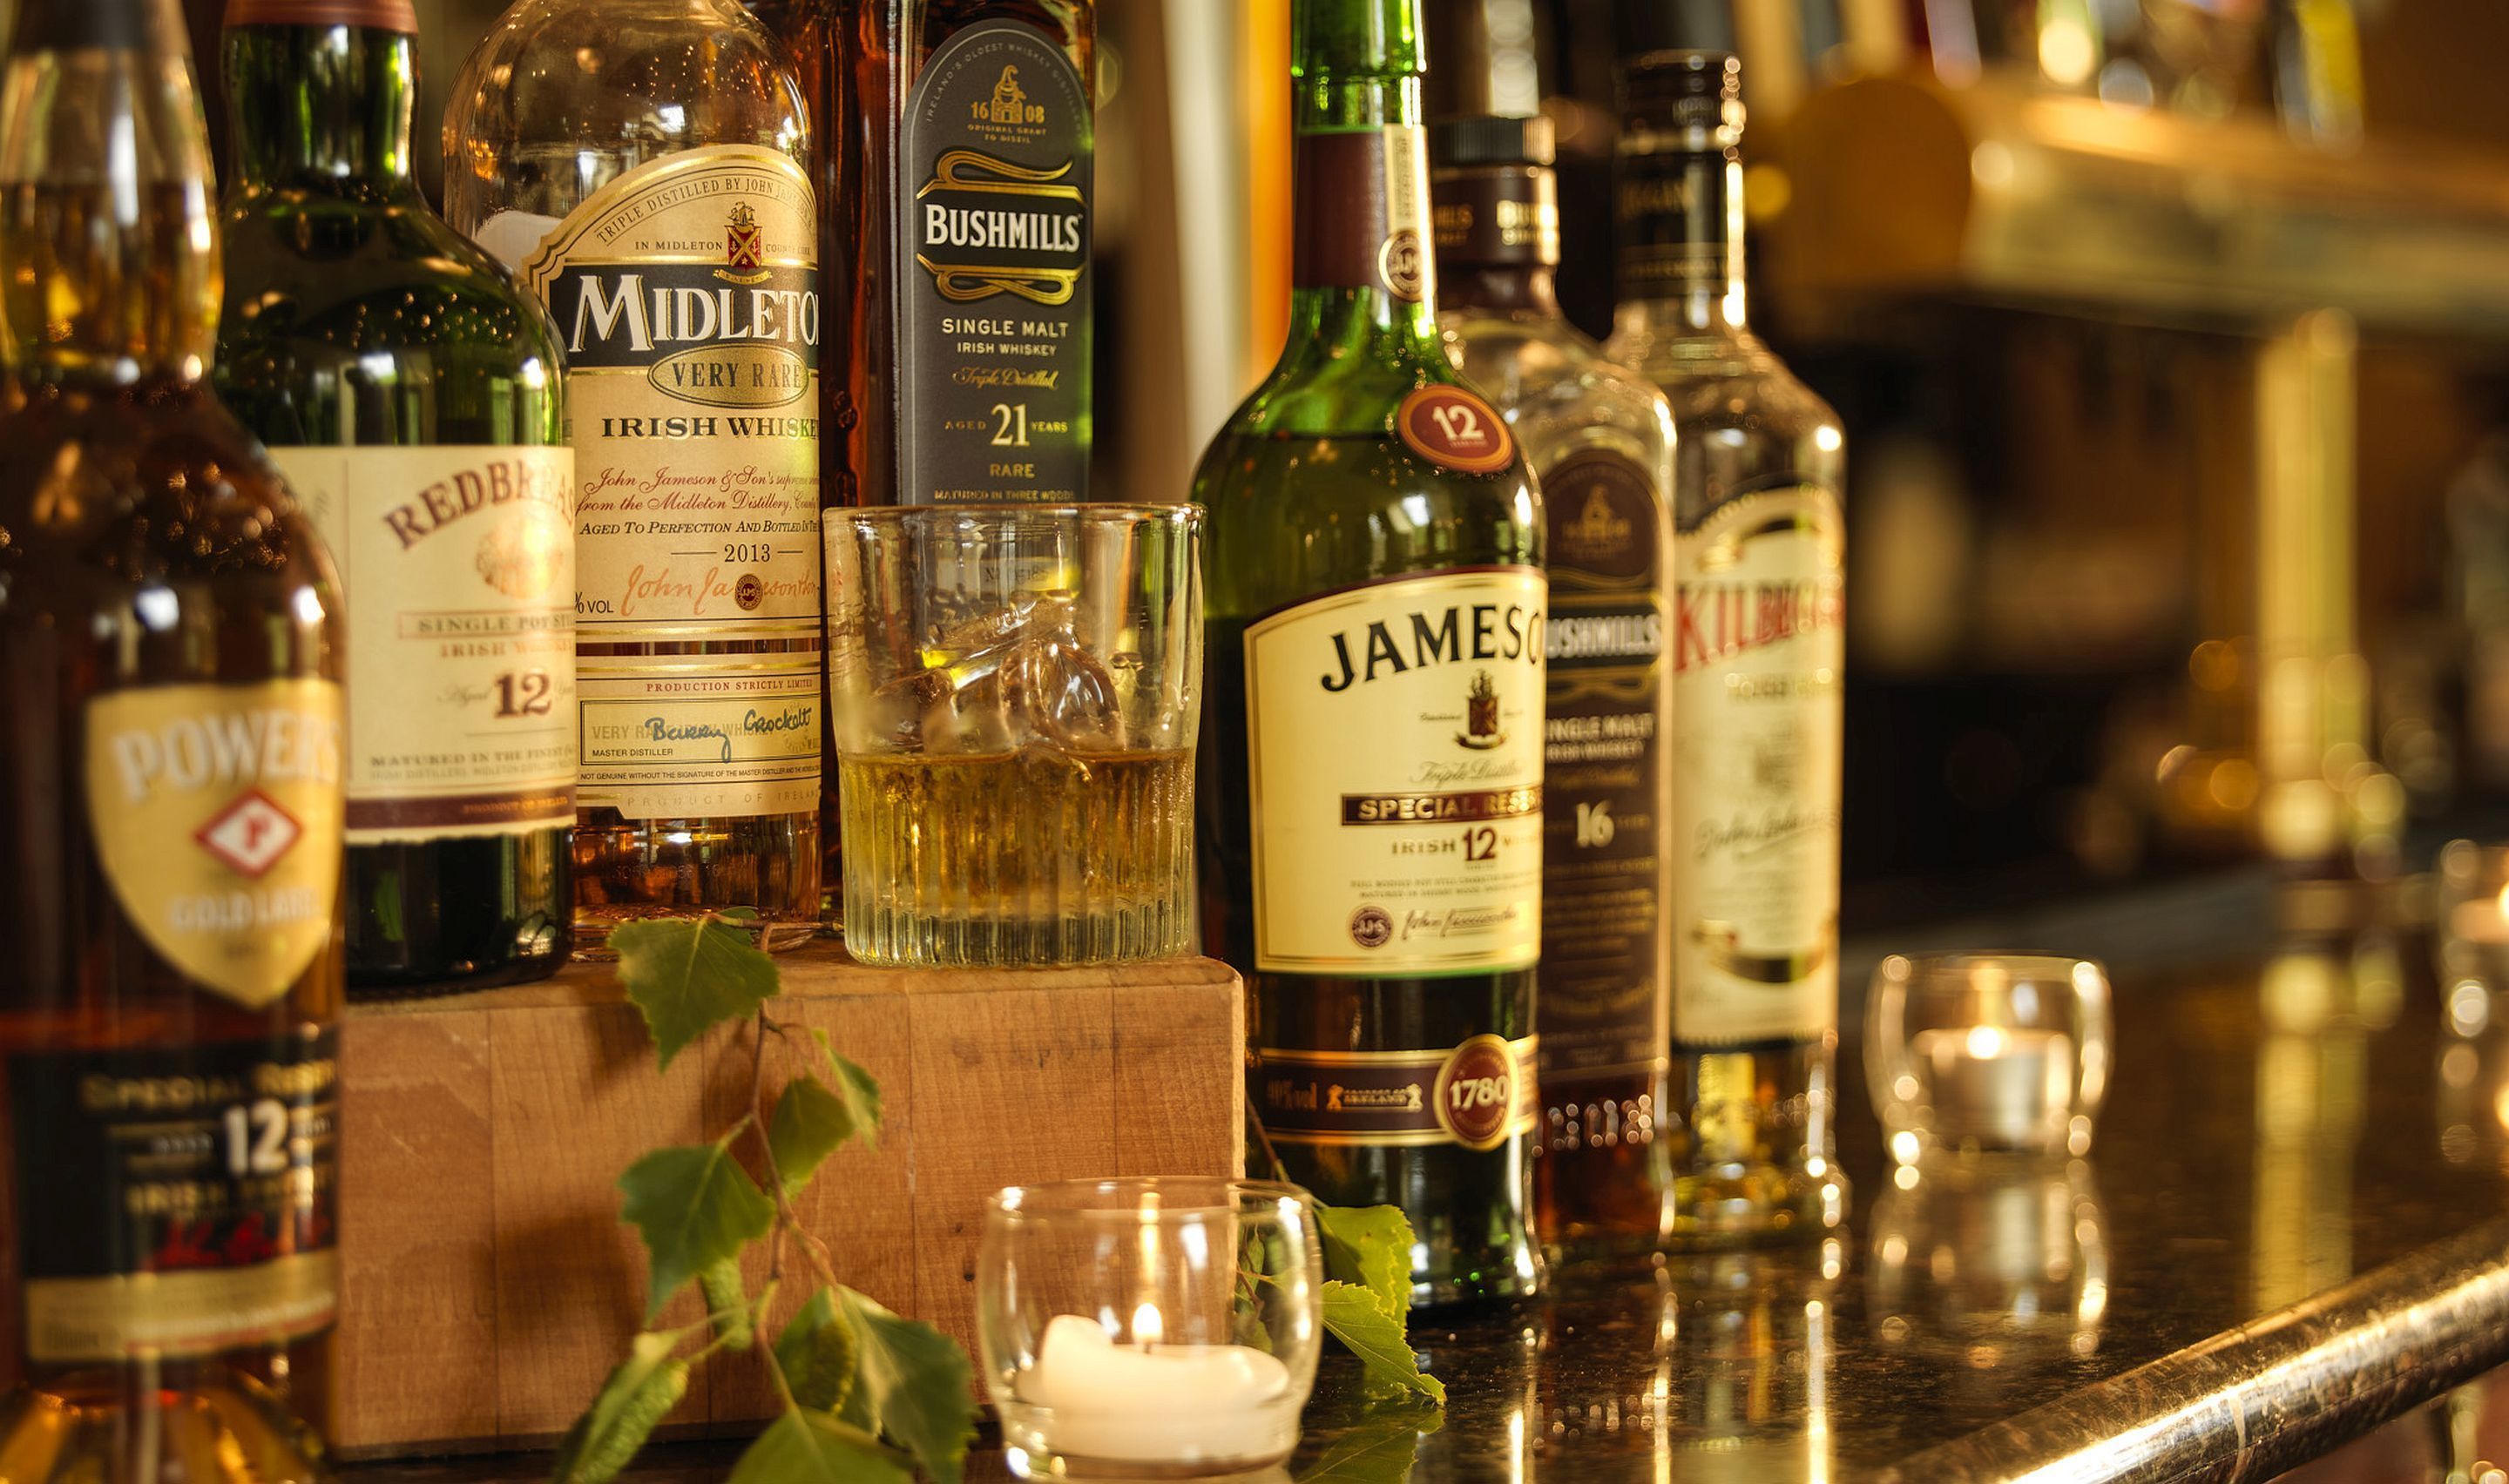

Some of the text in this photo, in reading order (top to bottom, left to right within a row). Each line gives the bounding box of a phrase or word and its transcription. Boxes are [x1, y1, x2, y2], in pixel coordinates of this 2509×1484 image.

[970, 101, 1045, 124] 16 08
[596, 206, 645, 245] TRIPLE
[646, 179, 720, 211] DISTILLED
[726, 178, 741, 191] BY
[746, 178, 774, 193] JOHN
[925, 203, 1080, 253] BUSHMILLS
[635, 241, 649, 250] IN
[655, 240, 723, 250] MIDLETON
[941, 318, 1069, 339] SINGLE MALT
[957, 342, 1057, 357] IRISH WHISKEY
[672, 363, 801, 388] VERY RARE
[951, 366, 1000, 389] Triple
[601, 417, 718, 438] IRISH
[944, 403, 1068, 447] AGED 21 YEARS
[1431, 405, 1485, 441] 12
[584, 467, 637, 495] John
[639, 466, 717, 494] Jameson
[990, 463, 1036, 479] RARE
[575, 493, 615, 516] from
[619, 493, 643, 510] the
[647, 491, 727, 512] Midleton
[732, 489, 792, 516] Distillery,
[934, 489, 989, 501] MATURED
[991, 489, 1002, 500] IN
[1006, 489, 1038, 502] THREE
[724, 543, 771, 563] 2013
[619, 563, 693, 617] John
[587, 599, 614, 614] VOL
[418, 615, 511, 634] SINGLE
[494, 671, 553, 719] 12
[646, 678, 813, 692] PRODUCTION STRICTLY LIMITED
[592, 725, 630, 740] VERY
[370, 753, 465, 767] MATURED
[471, 752, 489, 764] IN
[495, 749, 521, 763] THE
[592, 748, 673, 758] MASTER DISTILLER
[744, 793, 763, 803] OF
[1357, 795, 1475, 821] SPECIAL
[1576, 799, 1615, 848] 16
[1391, 839, 1457, 855] IRISH
[1463, 827, 1497, 862] 12
[1449, 1075, 1509, 1111] 1780
[225, 1097, 289, 1176] 12
